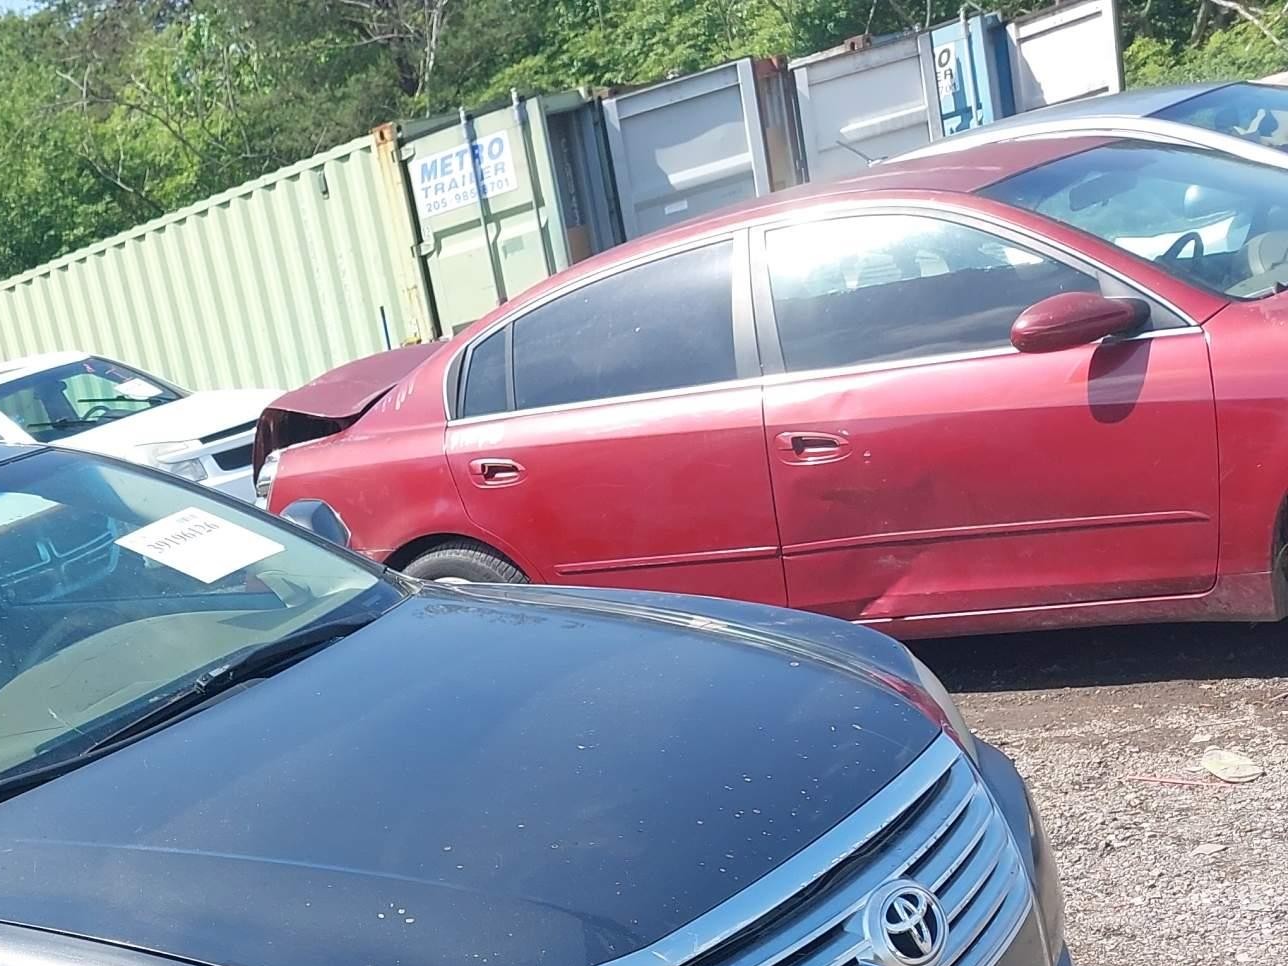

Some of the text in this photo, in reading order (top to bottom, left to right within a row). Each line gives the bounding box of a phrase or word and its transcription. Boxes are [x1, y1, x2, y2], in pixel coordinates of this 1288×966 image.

[420, 137, 504, 184] METRO
[421, 162, 506, 199] TRAILER
[147, 519, 220, 554] 39196126
